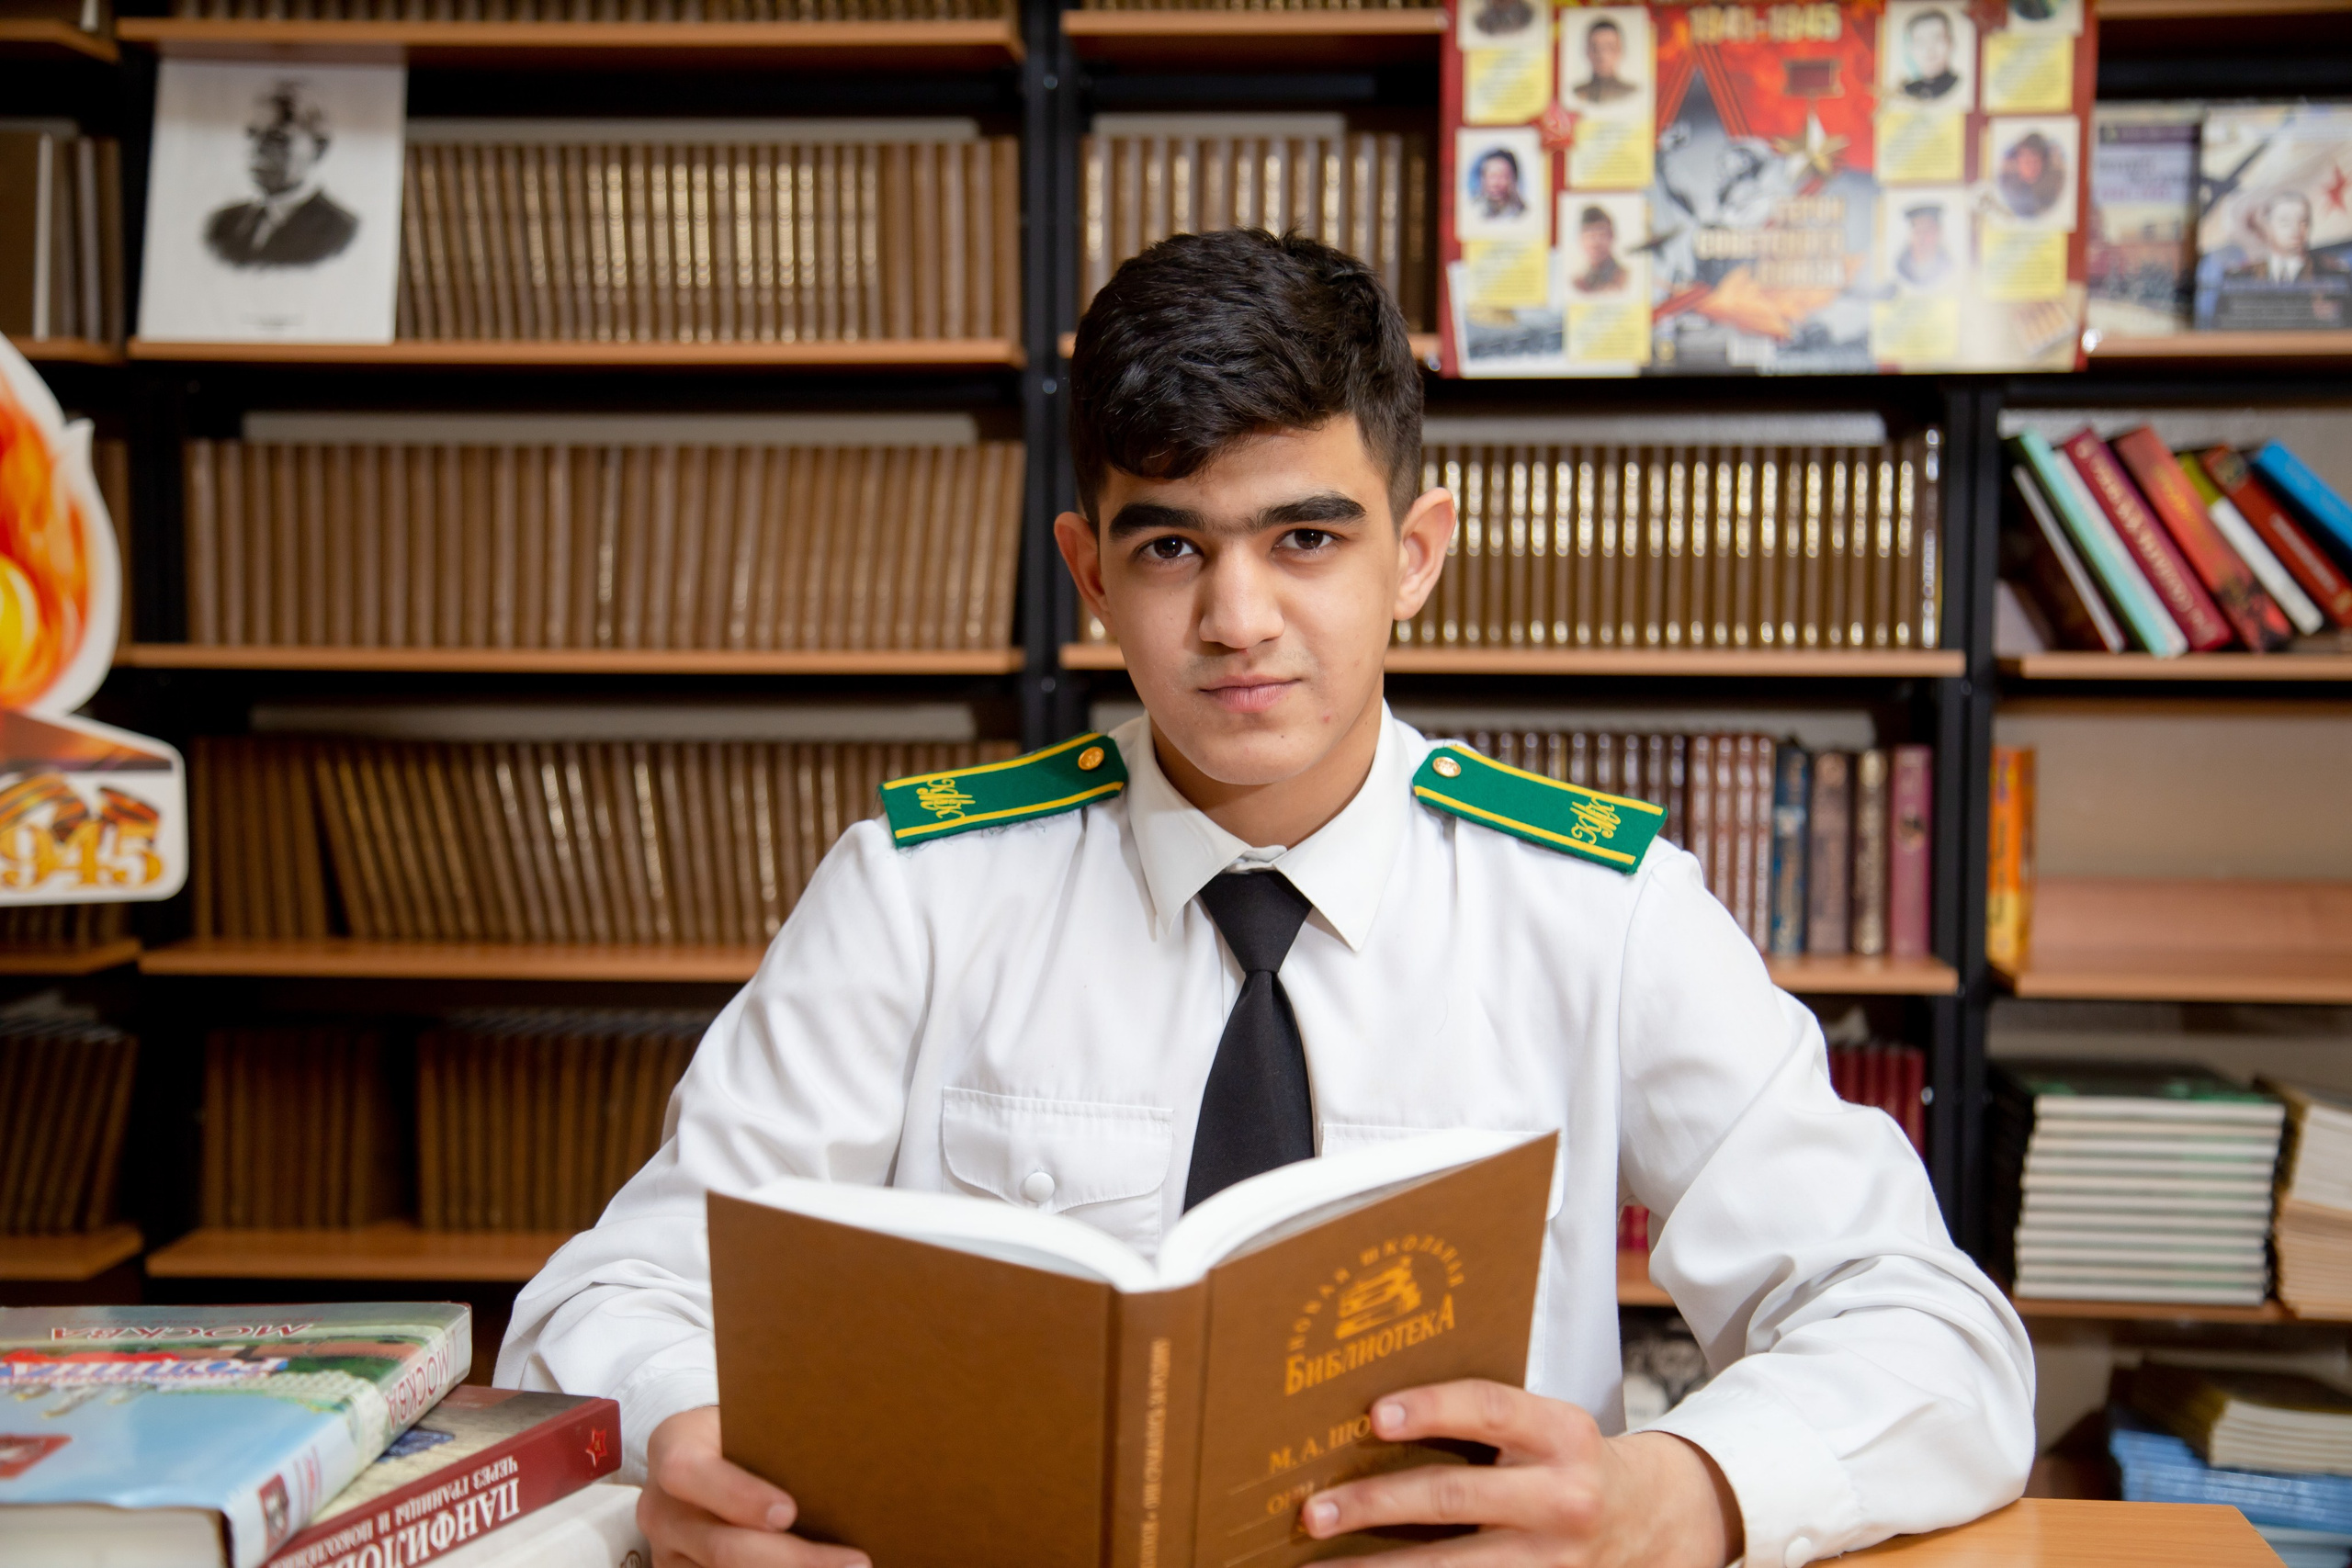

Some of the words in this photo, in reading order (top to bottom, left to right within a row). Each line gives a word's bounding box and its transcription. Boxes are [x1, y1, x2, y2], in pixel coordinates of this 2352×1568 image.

[1288, 1266, 1351, 1353] НОВАЯ
[1359, 1234, 1465, 1288] ШКОЛЬНАЯ
[51, 1324, 314, 1341] МОСКВА
[385, 1342, 449, 1431] МОСКВА
[1329, 1415, 1370, 1449] ШО
[472, 1455, 519, 1490] ЧЕРЕЗ
